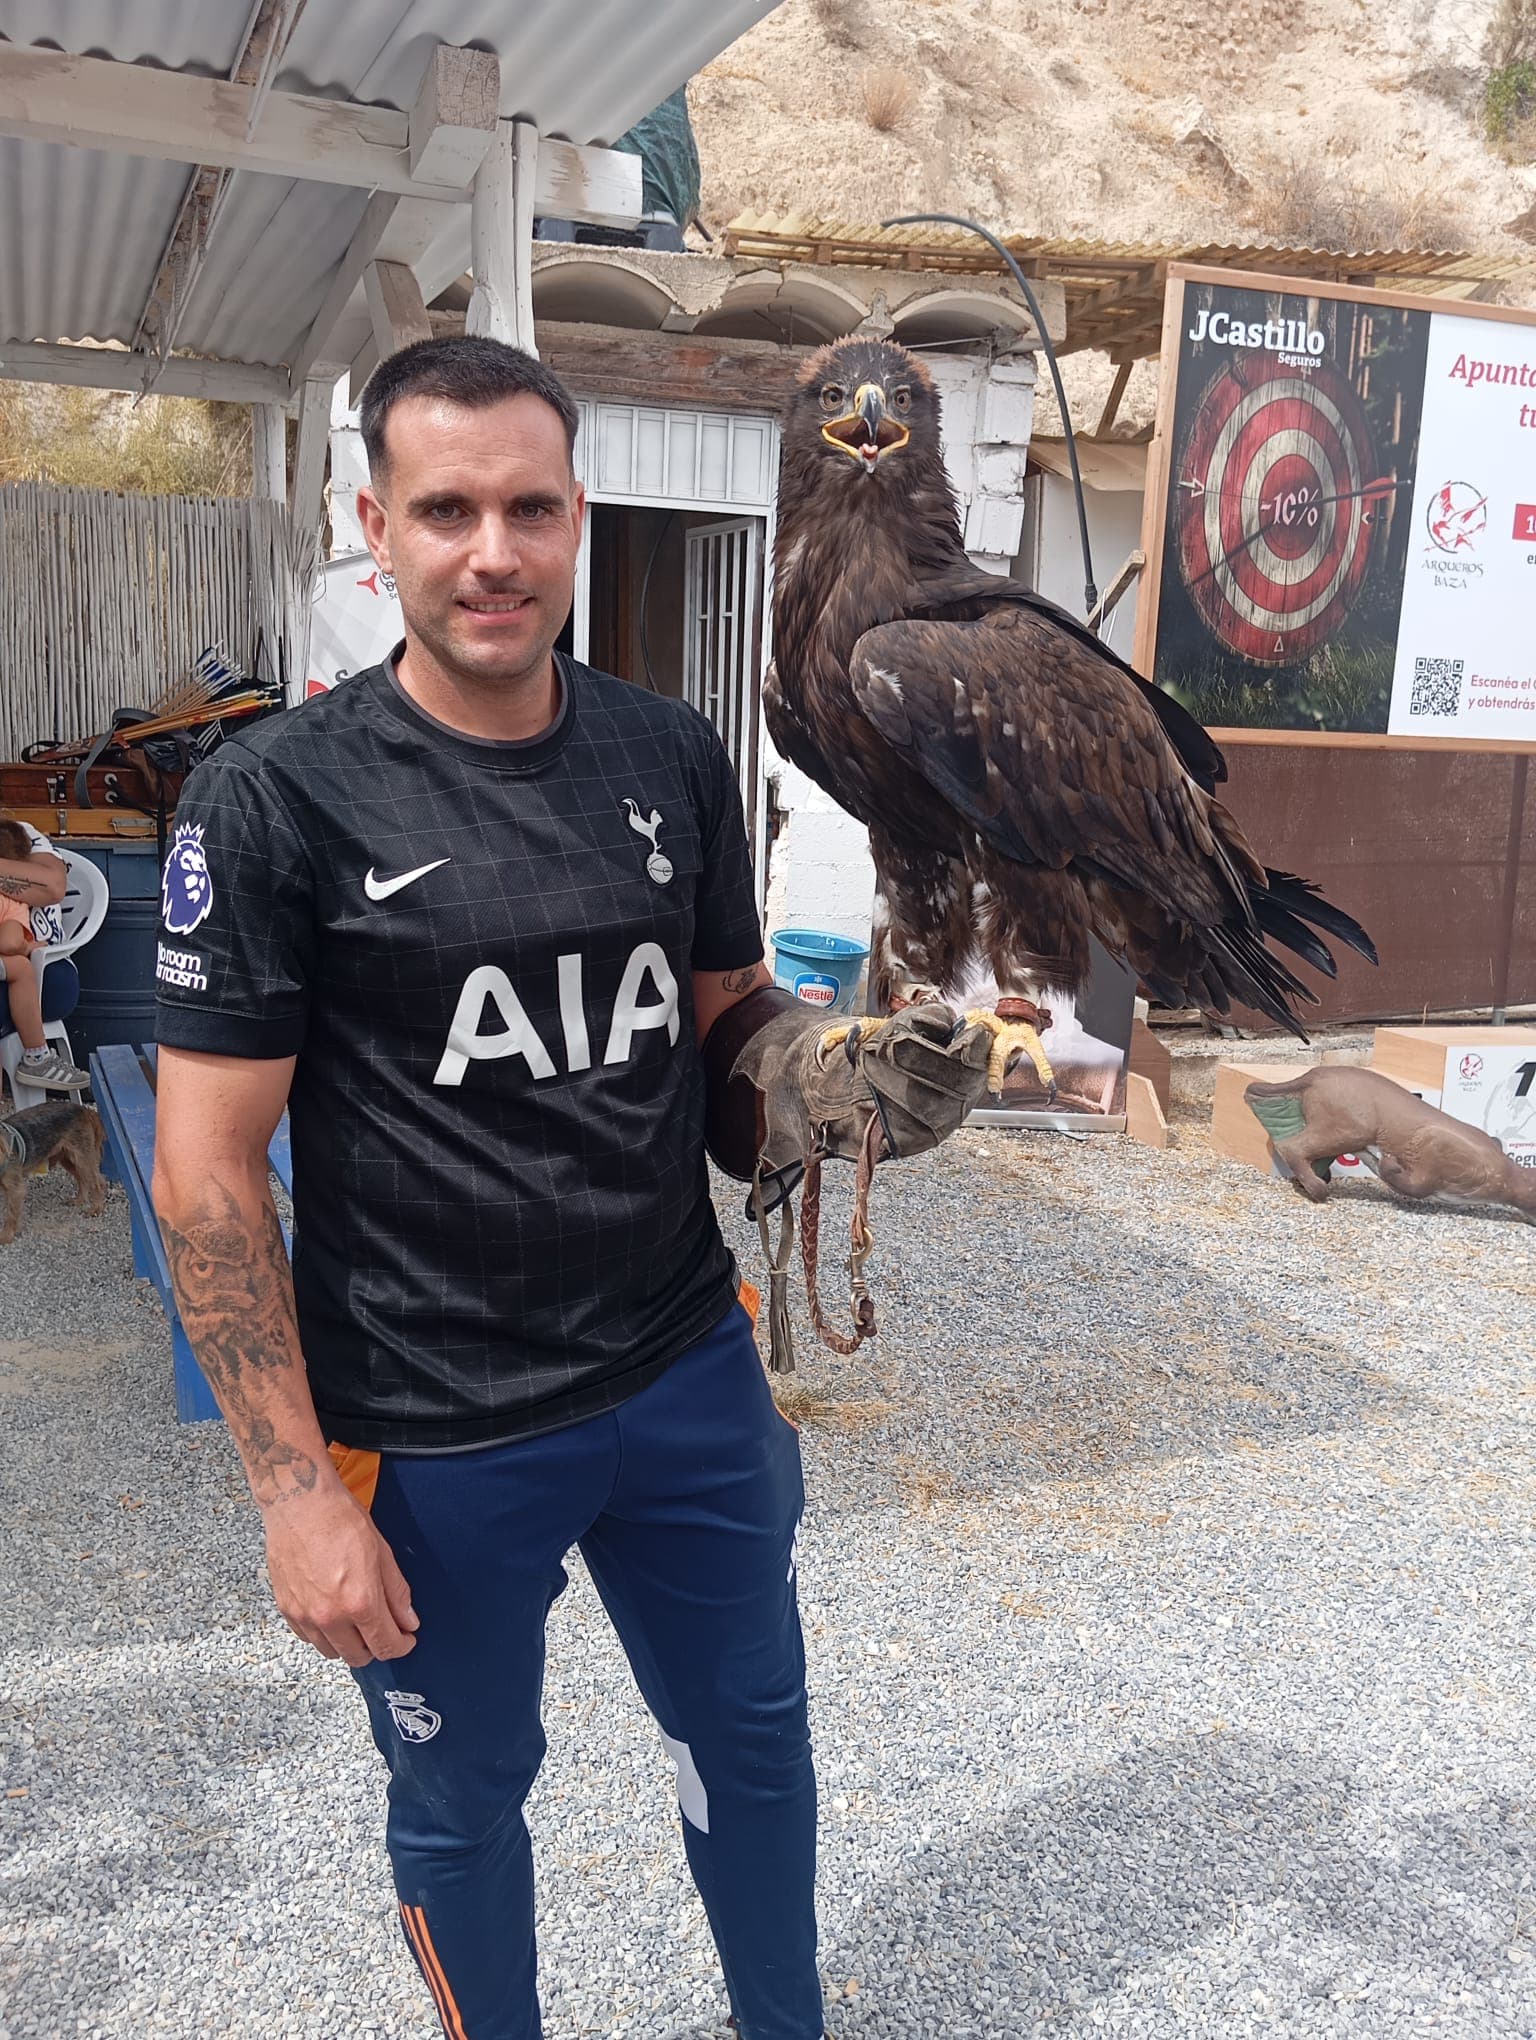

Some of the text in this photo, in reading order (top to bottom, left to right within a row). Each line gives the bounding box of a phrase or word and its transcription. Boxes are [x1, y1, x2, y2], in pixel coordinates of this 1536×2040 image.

[1189, 310, 1325, 355] JCastillo
[1277, 352, 1322, 368] Seguros
[1260, 487, 1319, 528] -10%
[1421, 559, 1484, 577] ARQUEROS
[1434, 575, 1467, 589] BAZA
[1470, 674, 1519, 689] Escanéa
[1521, 677, 1531, 690] el
[1468, 695, 1535, 710] y obtendrás
[165, 949, 201, 972] room
[161, 966, 208, 991] racism
[433, 942, 681, 1086] AIA
